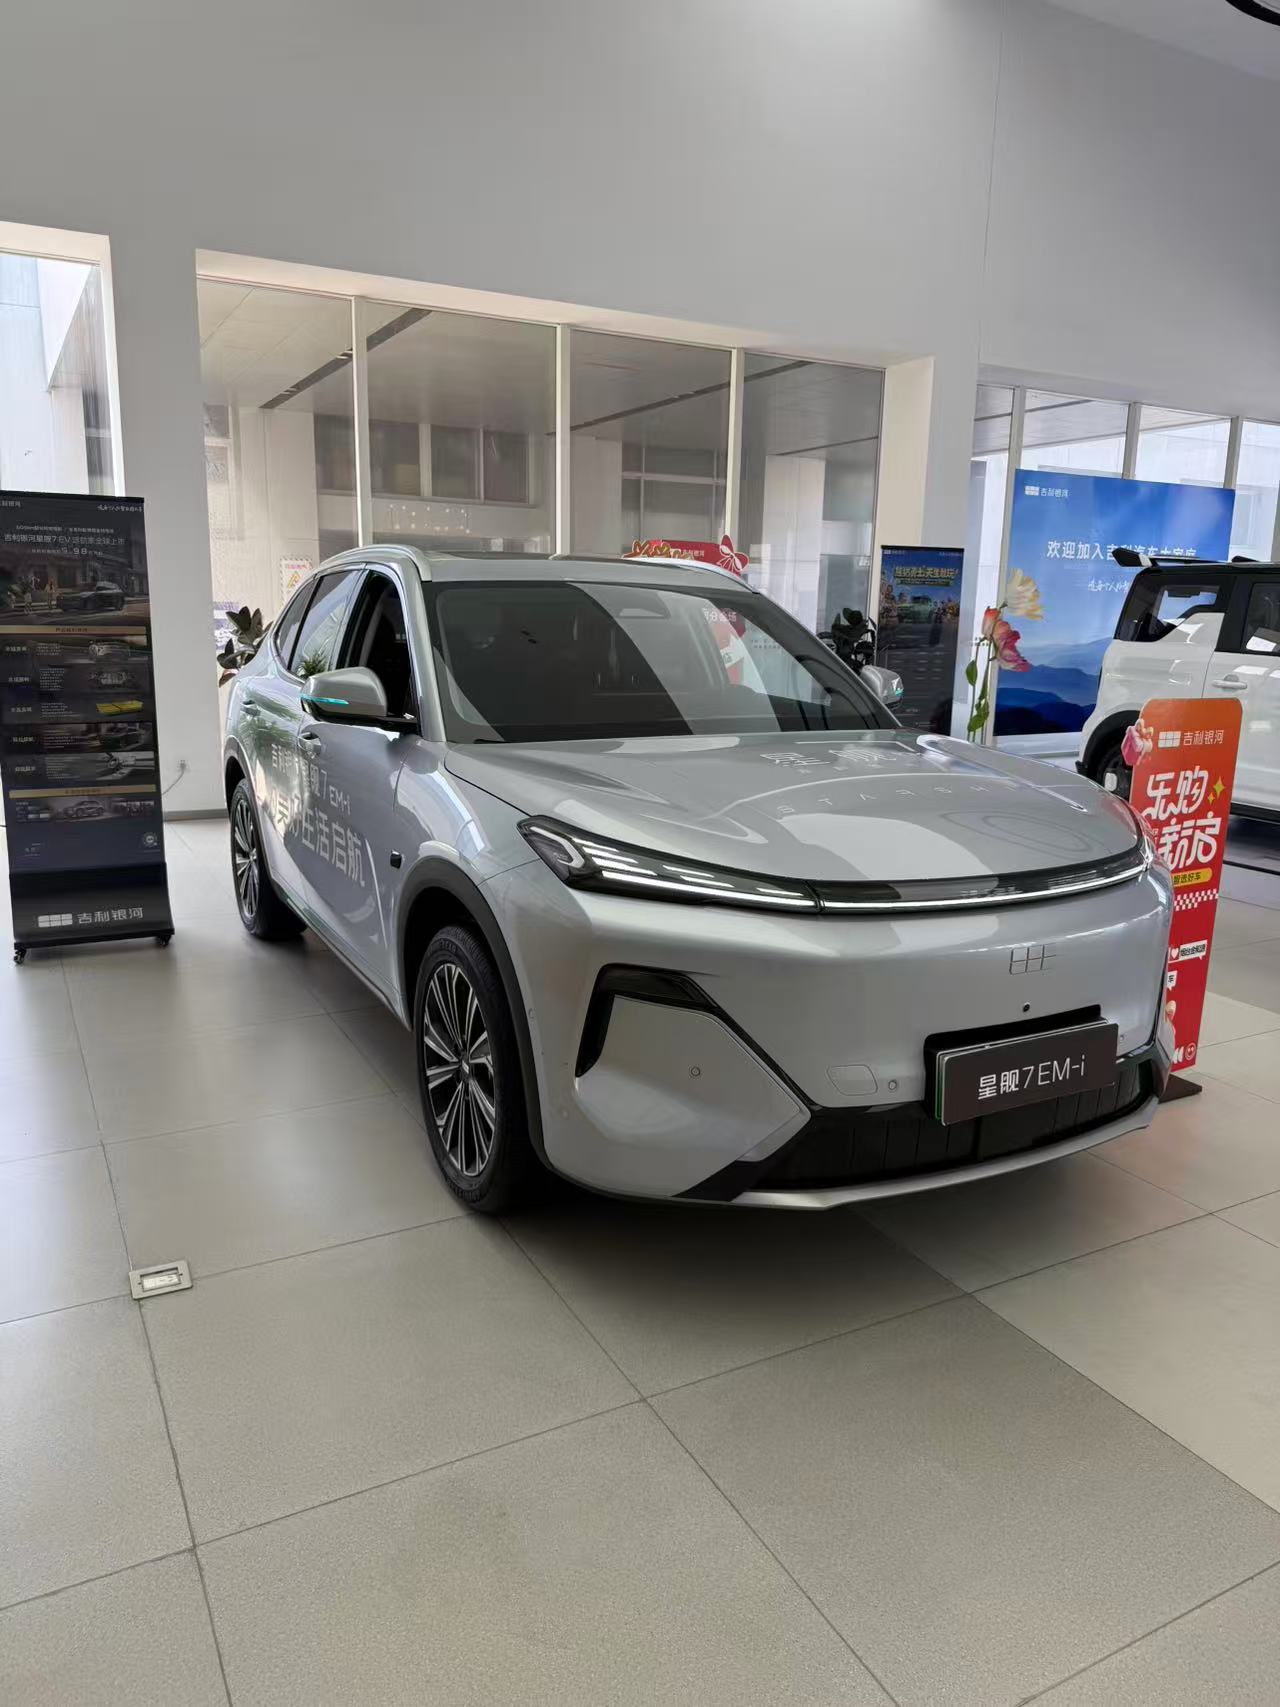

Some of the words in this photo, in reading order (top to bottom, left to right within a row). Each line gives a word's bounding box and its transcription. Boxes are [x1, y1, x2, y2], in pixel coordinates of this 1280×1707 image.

[1040, 487, 1069, 498] 吉利银河
[1184, 729, 1224, 746] 吉利银河
[77, 907, 144, 925] 吉利银河
[978, 1055, 1086, 1100] 星舰7EM-i
